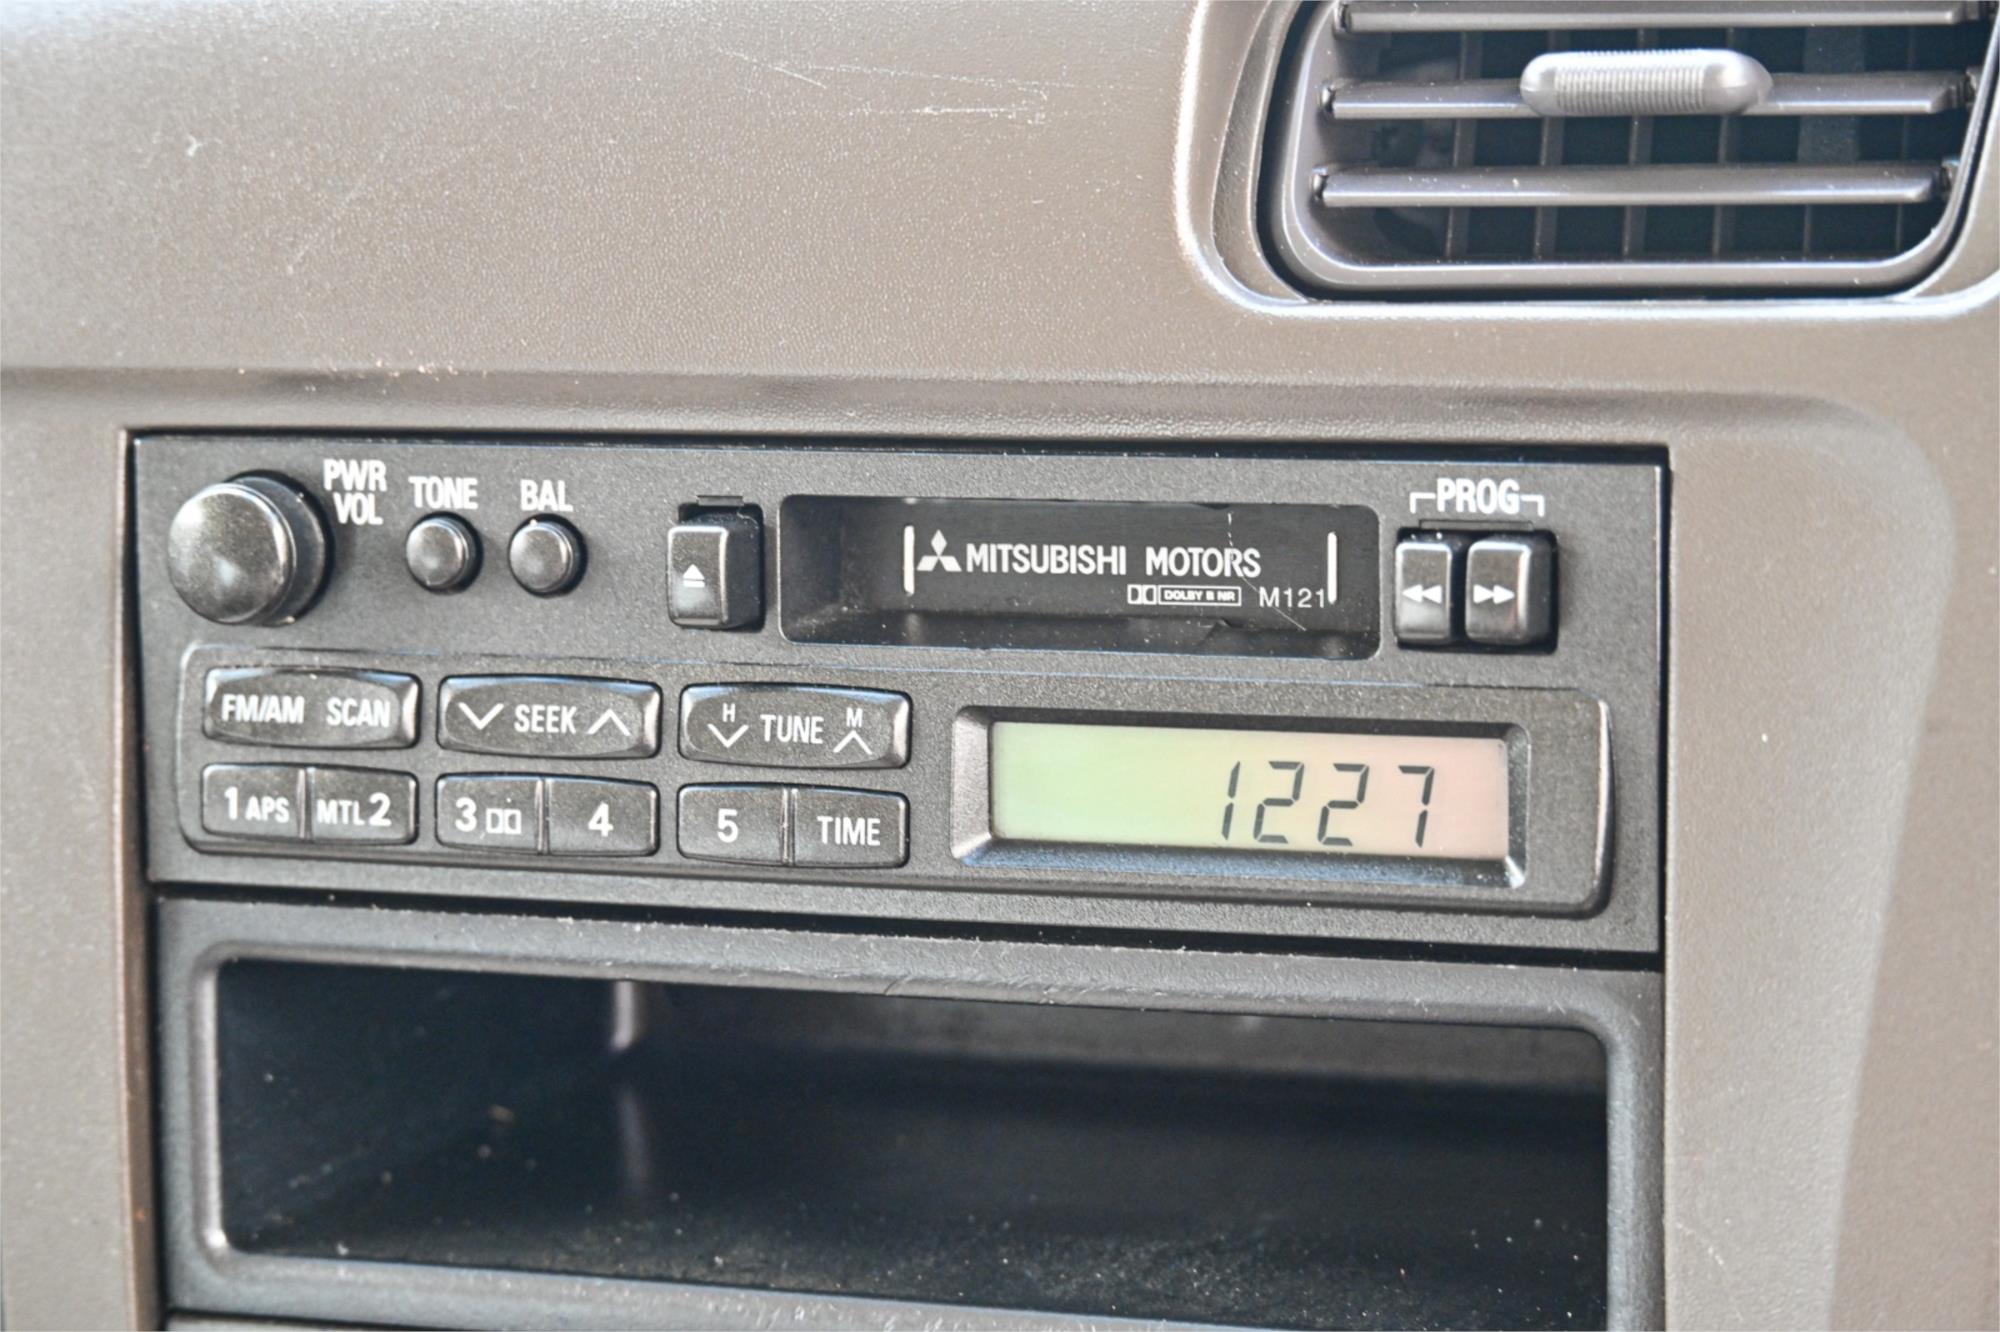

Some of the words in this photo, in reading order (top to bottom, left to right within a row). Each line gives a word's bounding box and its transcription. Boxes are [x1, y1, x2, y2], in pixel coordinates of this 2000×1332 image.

[323, 459, 388, 493] PWR
[333, 492, 384, 526] VOL
[408, 476, 478, 510] TONE
[519, 479, 573, 512] BAL
[1436, 478, 1521, 515] PROG
[966, 543, 1127, 576] MITSUBISHI
[1145, 546, 1262, 579] MOTORS
[1163, 589, 1203, 601] DOLBY
[1217, 591, 1236, 602] NR
[1259, 586, 1325, 609] M121
[221, 694, 305, 724] FM/AM
[326, 697, 391, 728] SCAN
[514, 704, 578, 735] SEEK
[722, 702, 736, 723] H
[846, 707, 863, 728] M
[760, 714, 825, 745] TUNE
[245, 796, 290, 824] APS
[588, 802, 614, 838] 4
[1221, 760, 1435, 848] 1227
[716, 808, 739, 844] 5
[817, 815, 881, 846] TIME
